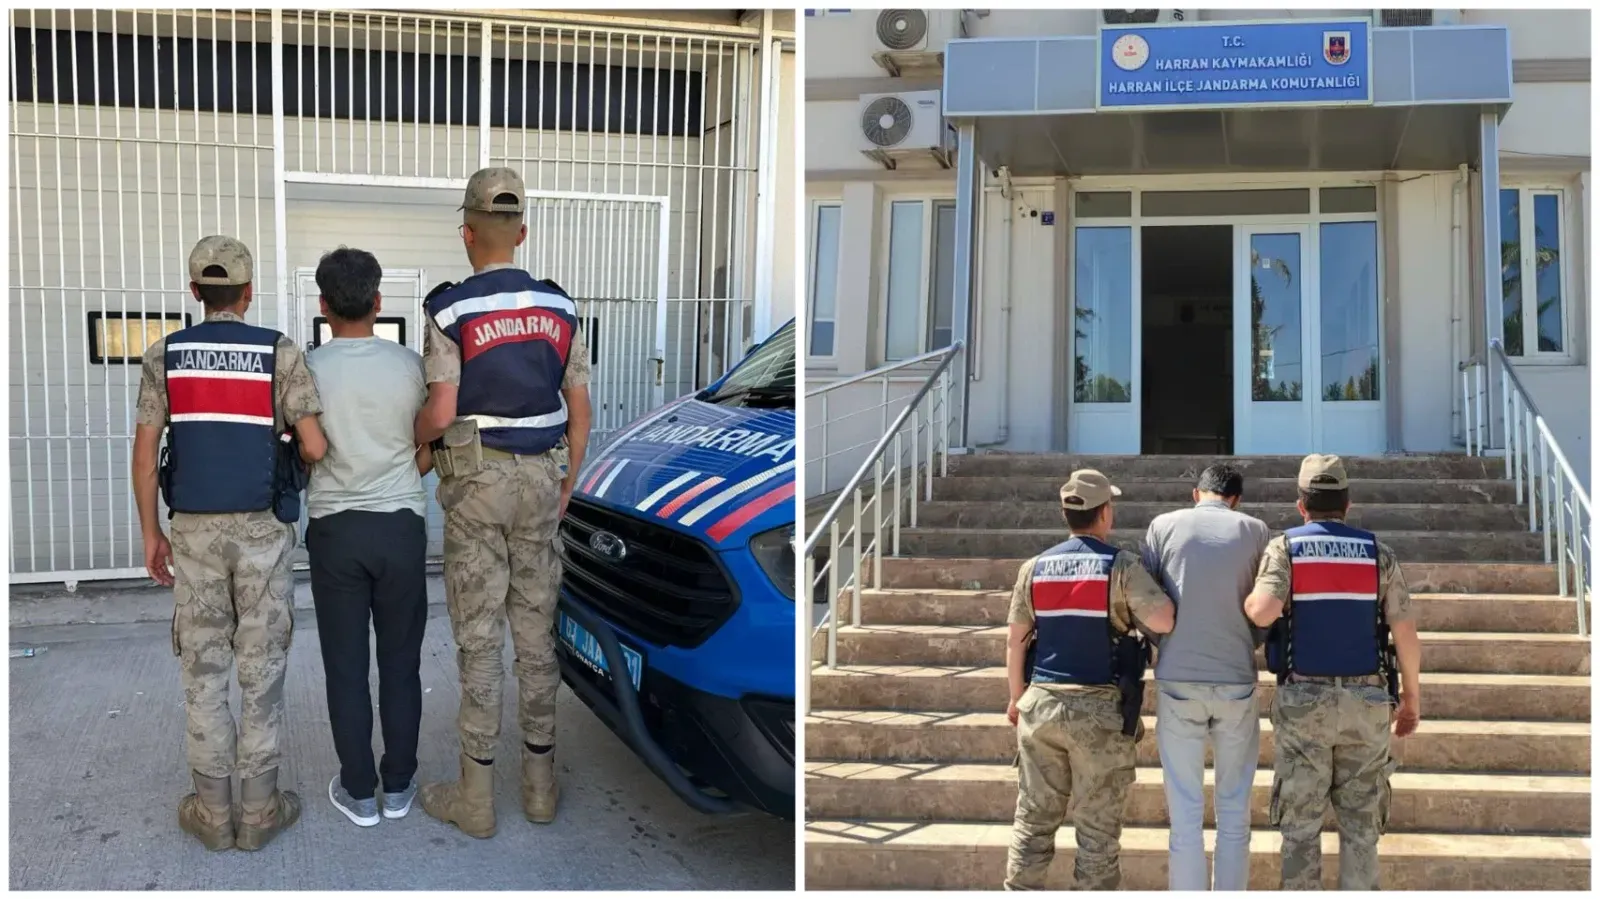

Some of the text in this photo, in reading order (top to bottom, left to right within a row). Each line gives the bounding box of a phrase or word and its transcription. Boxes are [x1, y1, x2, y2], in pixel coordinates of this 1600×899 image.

[1221, 35, 1245, 48] T.C.
[1155, 59, 1208, 71] HARRAN
[1211, 52, 1312, 69] KAYMAKAMLIĞI
[1109, 73, 1360, 94] HARRAN İLÇE JANDARMA KOMUTANLIĞI
[474, 315, 561, 346] JANDARMA
[175, 349, 264, 373] JANDARMA
[593, 534, 614, 555] Ford
[1298, 540, 1369, 558] JANDARMA
[1041, 559, 1103, 576] JANDARMA
